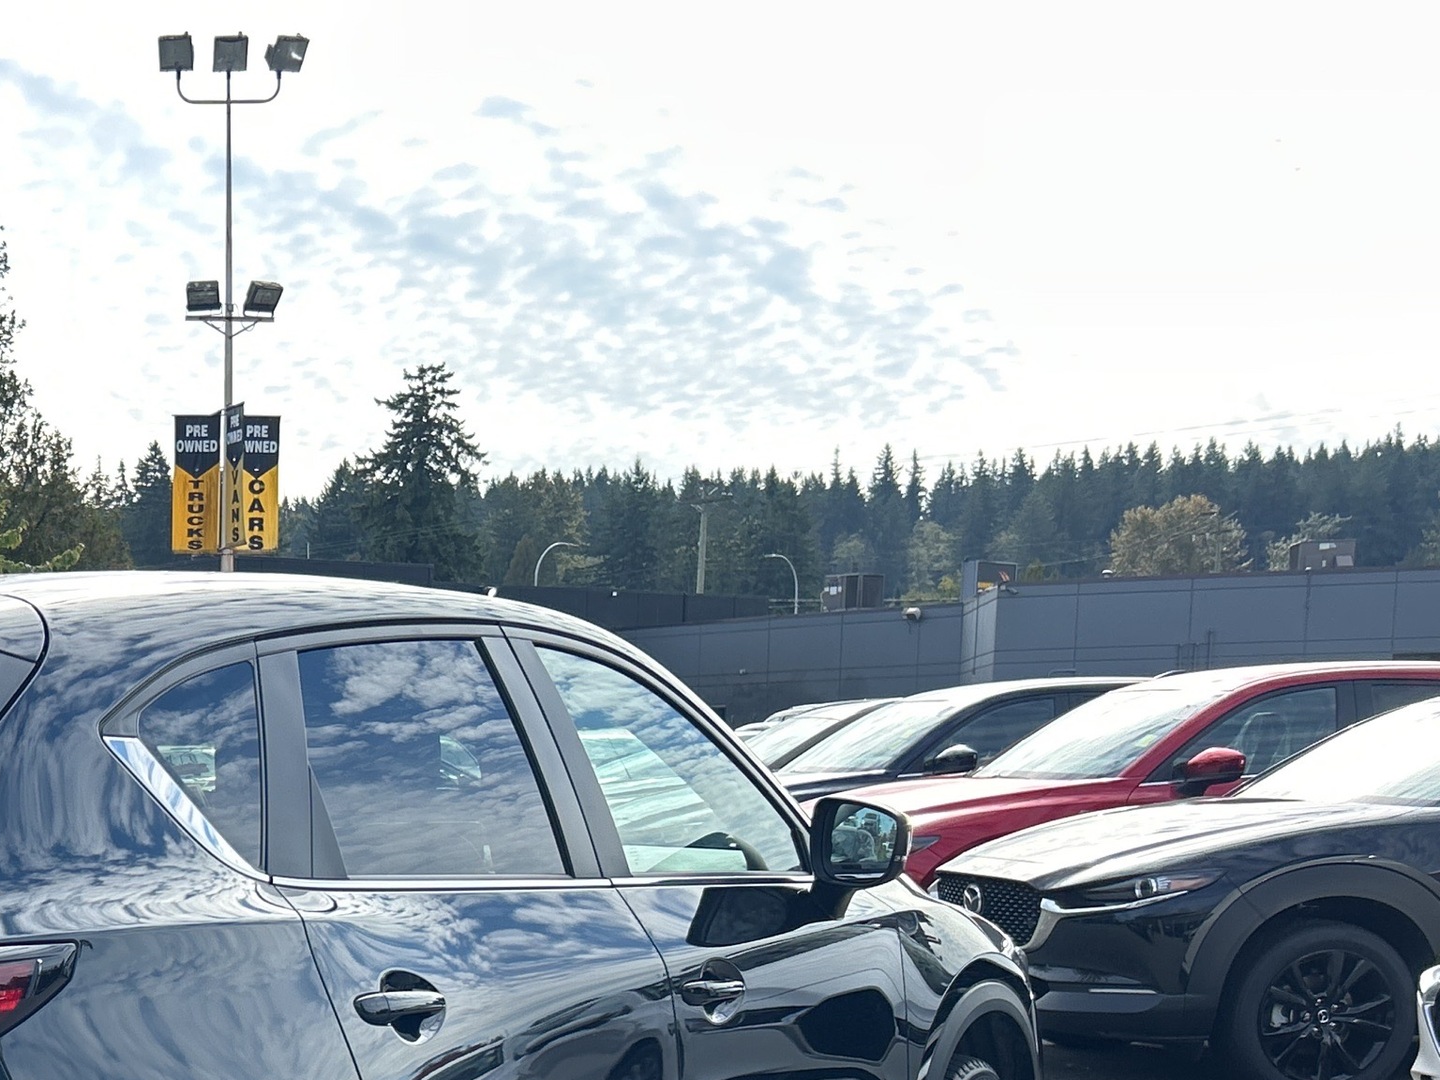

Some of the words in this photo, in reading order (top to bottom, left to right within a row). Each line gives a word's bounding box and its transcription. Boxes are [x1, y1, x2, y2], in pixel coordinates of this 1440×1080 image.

[185, 424, 209, 437] PRE
[246, 425, 269, 437] PRE
[176, 440, 218, 453] OWNED
[244, 440, 278, 453] WNED
[231, 469, 240, 542] VANS
[187, 479, 204, 550] TRUCKS
[248, 479, 265, 550] CARS
